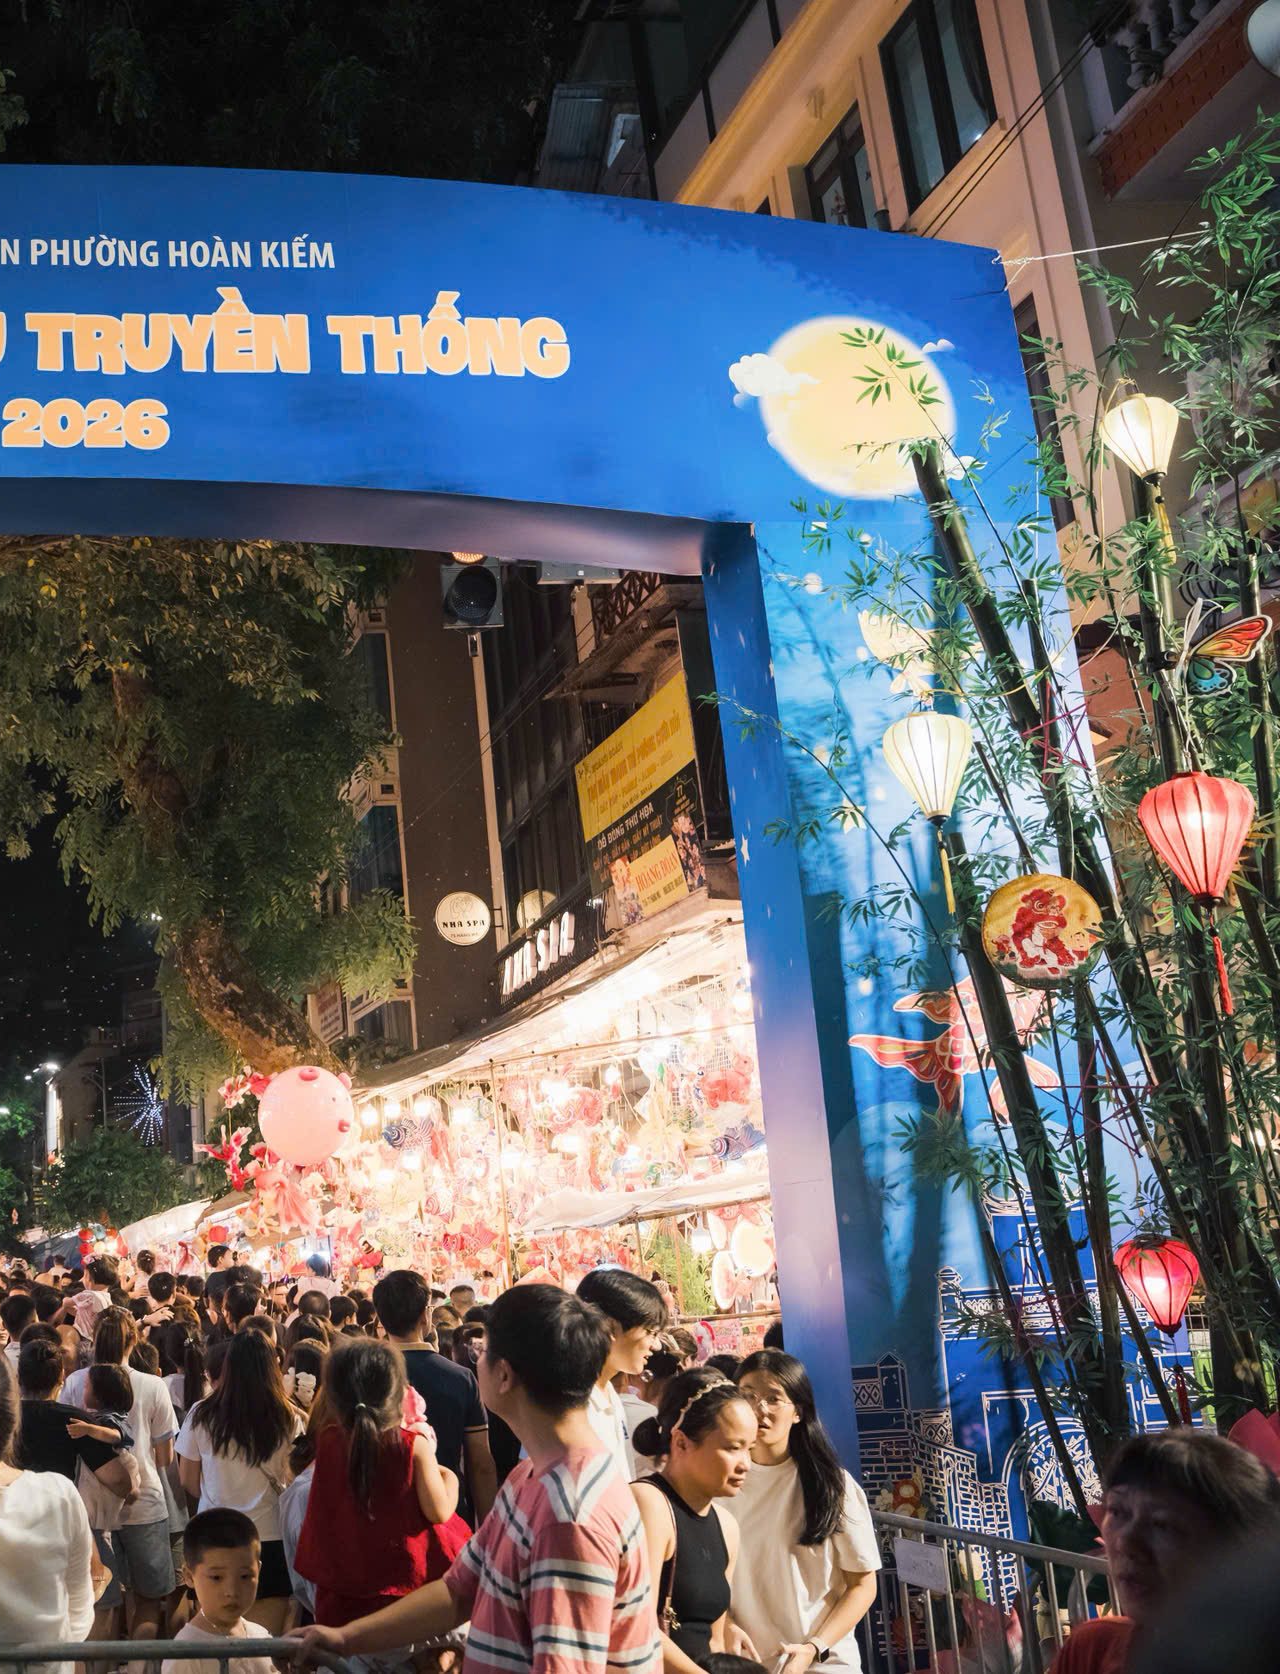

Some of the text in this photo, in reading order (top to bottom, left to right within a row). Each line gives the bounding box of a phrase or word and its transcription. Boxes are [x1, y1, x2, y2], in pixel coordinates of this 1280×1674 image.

[30, 235, 160, 268] PHƯỜNG
[168, 236, 252, 269] HOÀN
[261, 233, 336, 270] KIẾM
[25, 286, 311, 375] TRUYỀN
[326, 291, 571, 379] THỐNG
[1, 397, 170, 450] 2026
[467, 919, 485, 927] SPA
